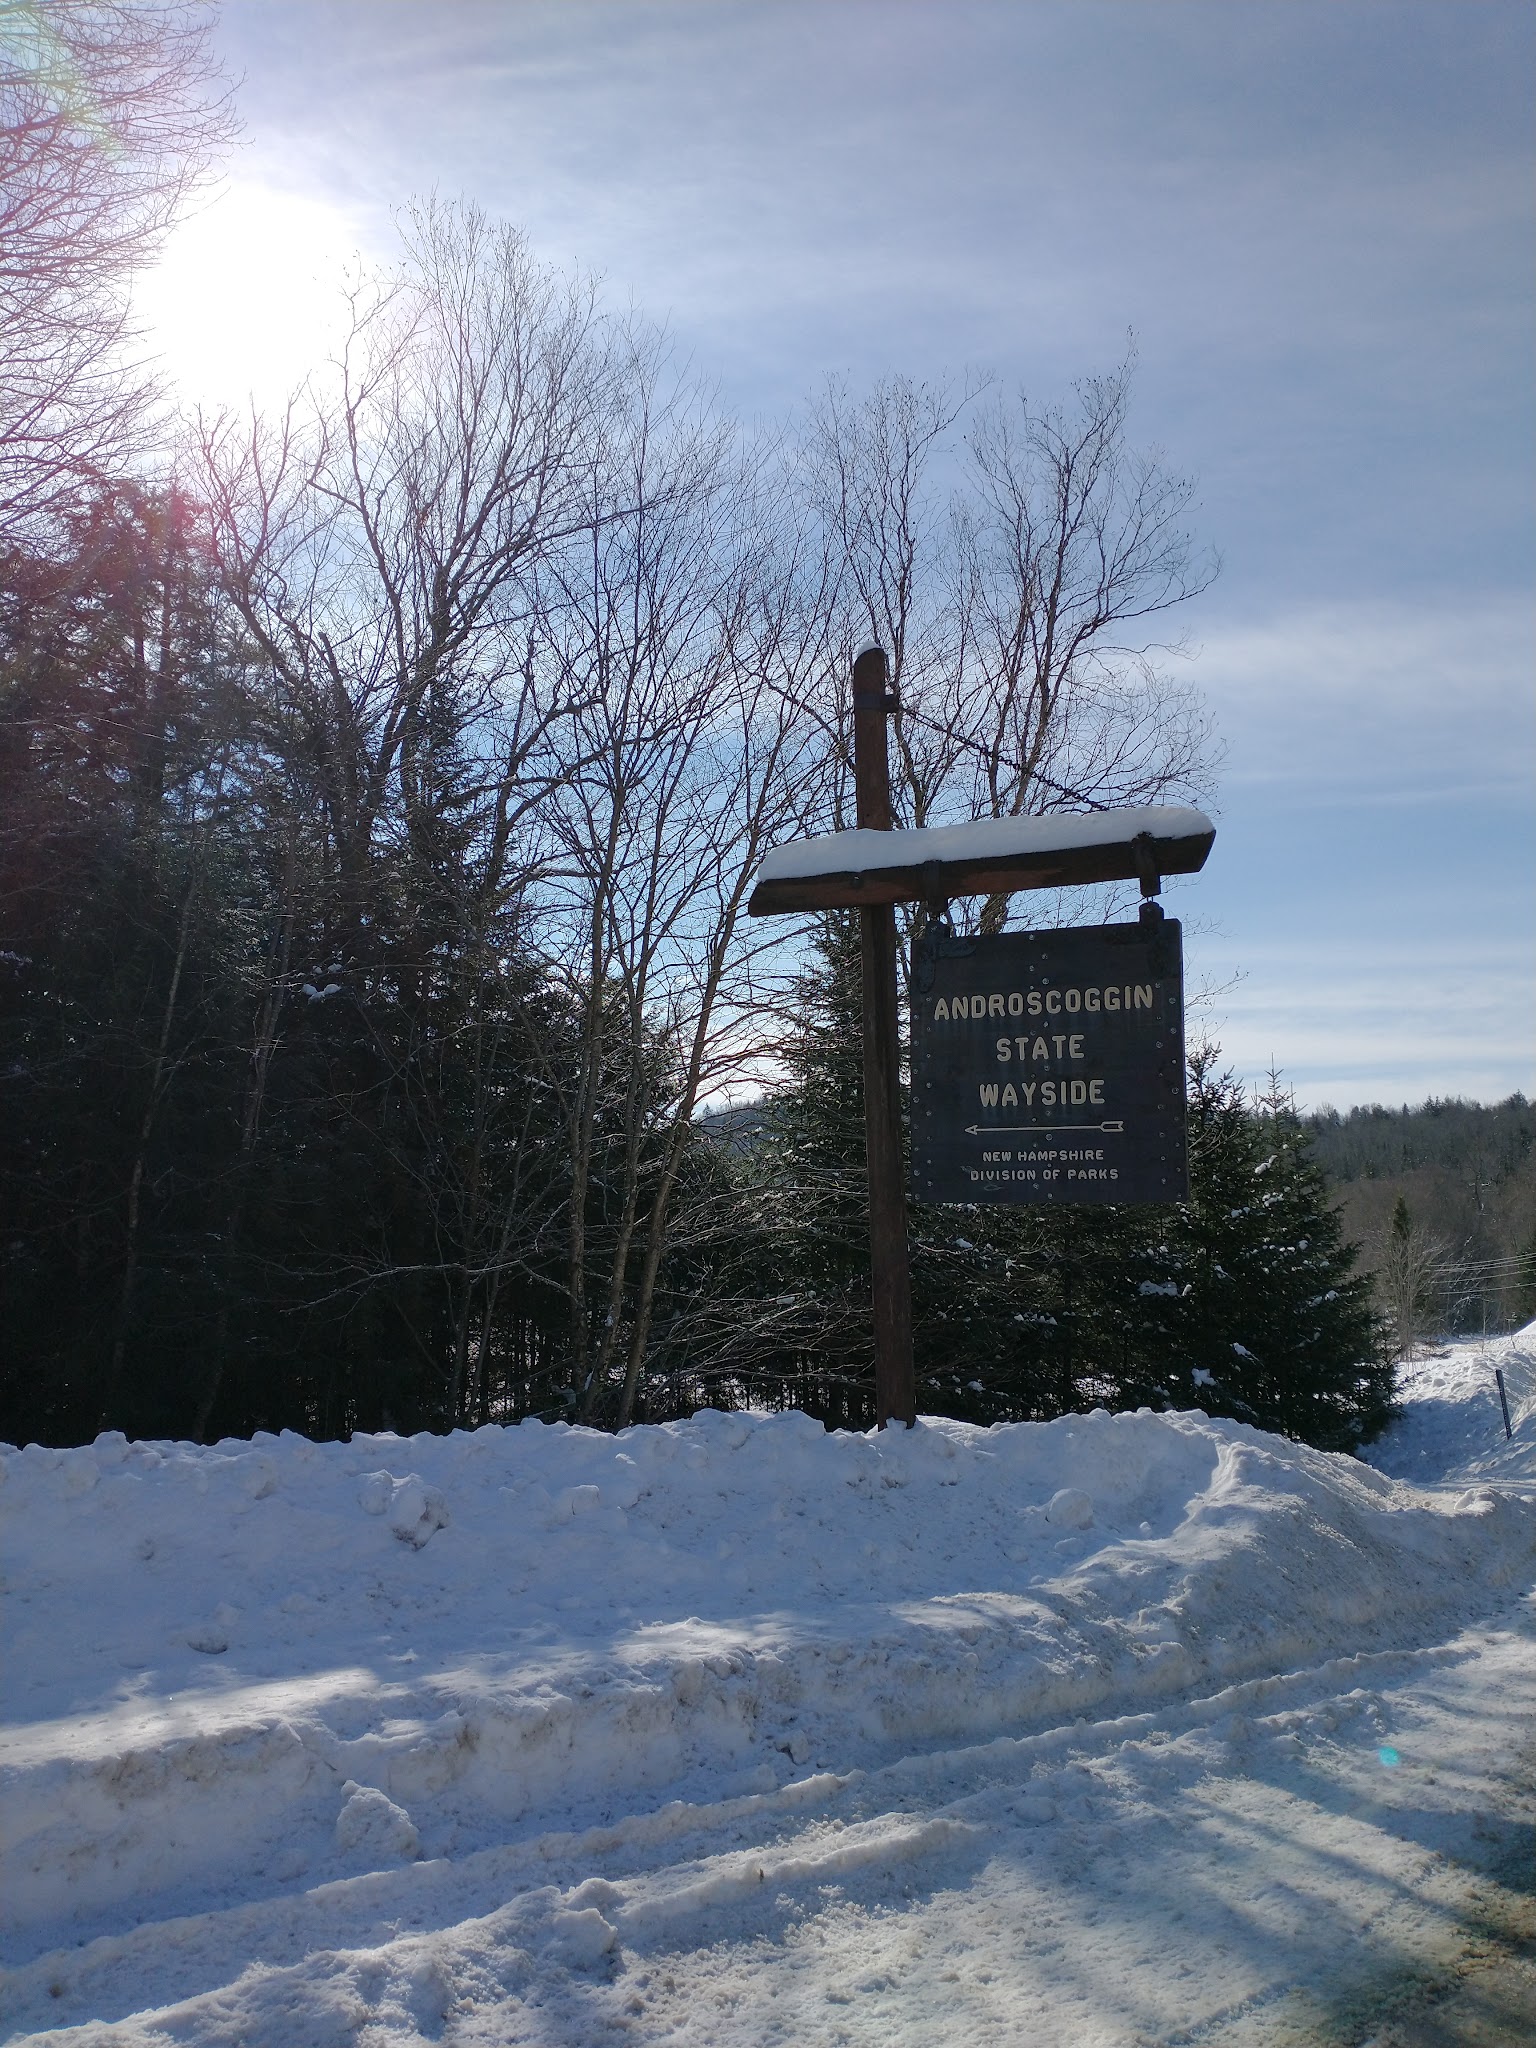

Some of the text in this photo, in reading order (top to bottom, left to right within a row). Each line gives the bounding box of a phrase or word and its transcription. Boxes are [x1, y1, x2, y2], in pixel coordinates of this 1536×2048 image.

[934, 984, 1154, 1021] ANDROSCOGGIN
[996, 1034, 1085, 1062] STATE
[979, 1079, 1106, 1108] WAYSIDE
[982, 1149, 1104, 1162] NEW HAMPSHIRE
[970, 1168, 1119, 1181] DIVISION OF PARKS
